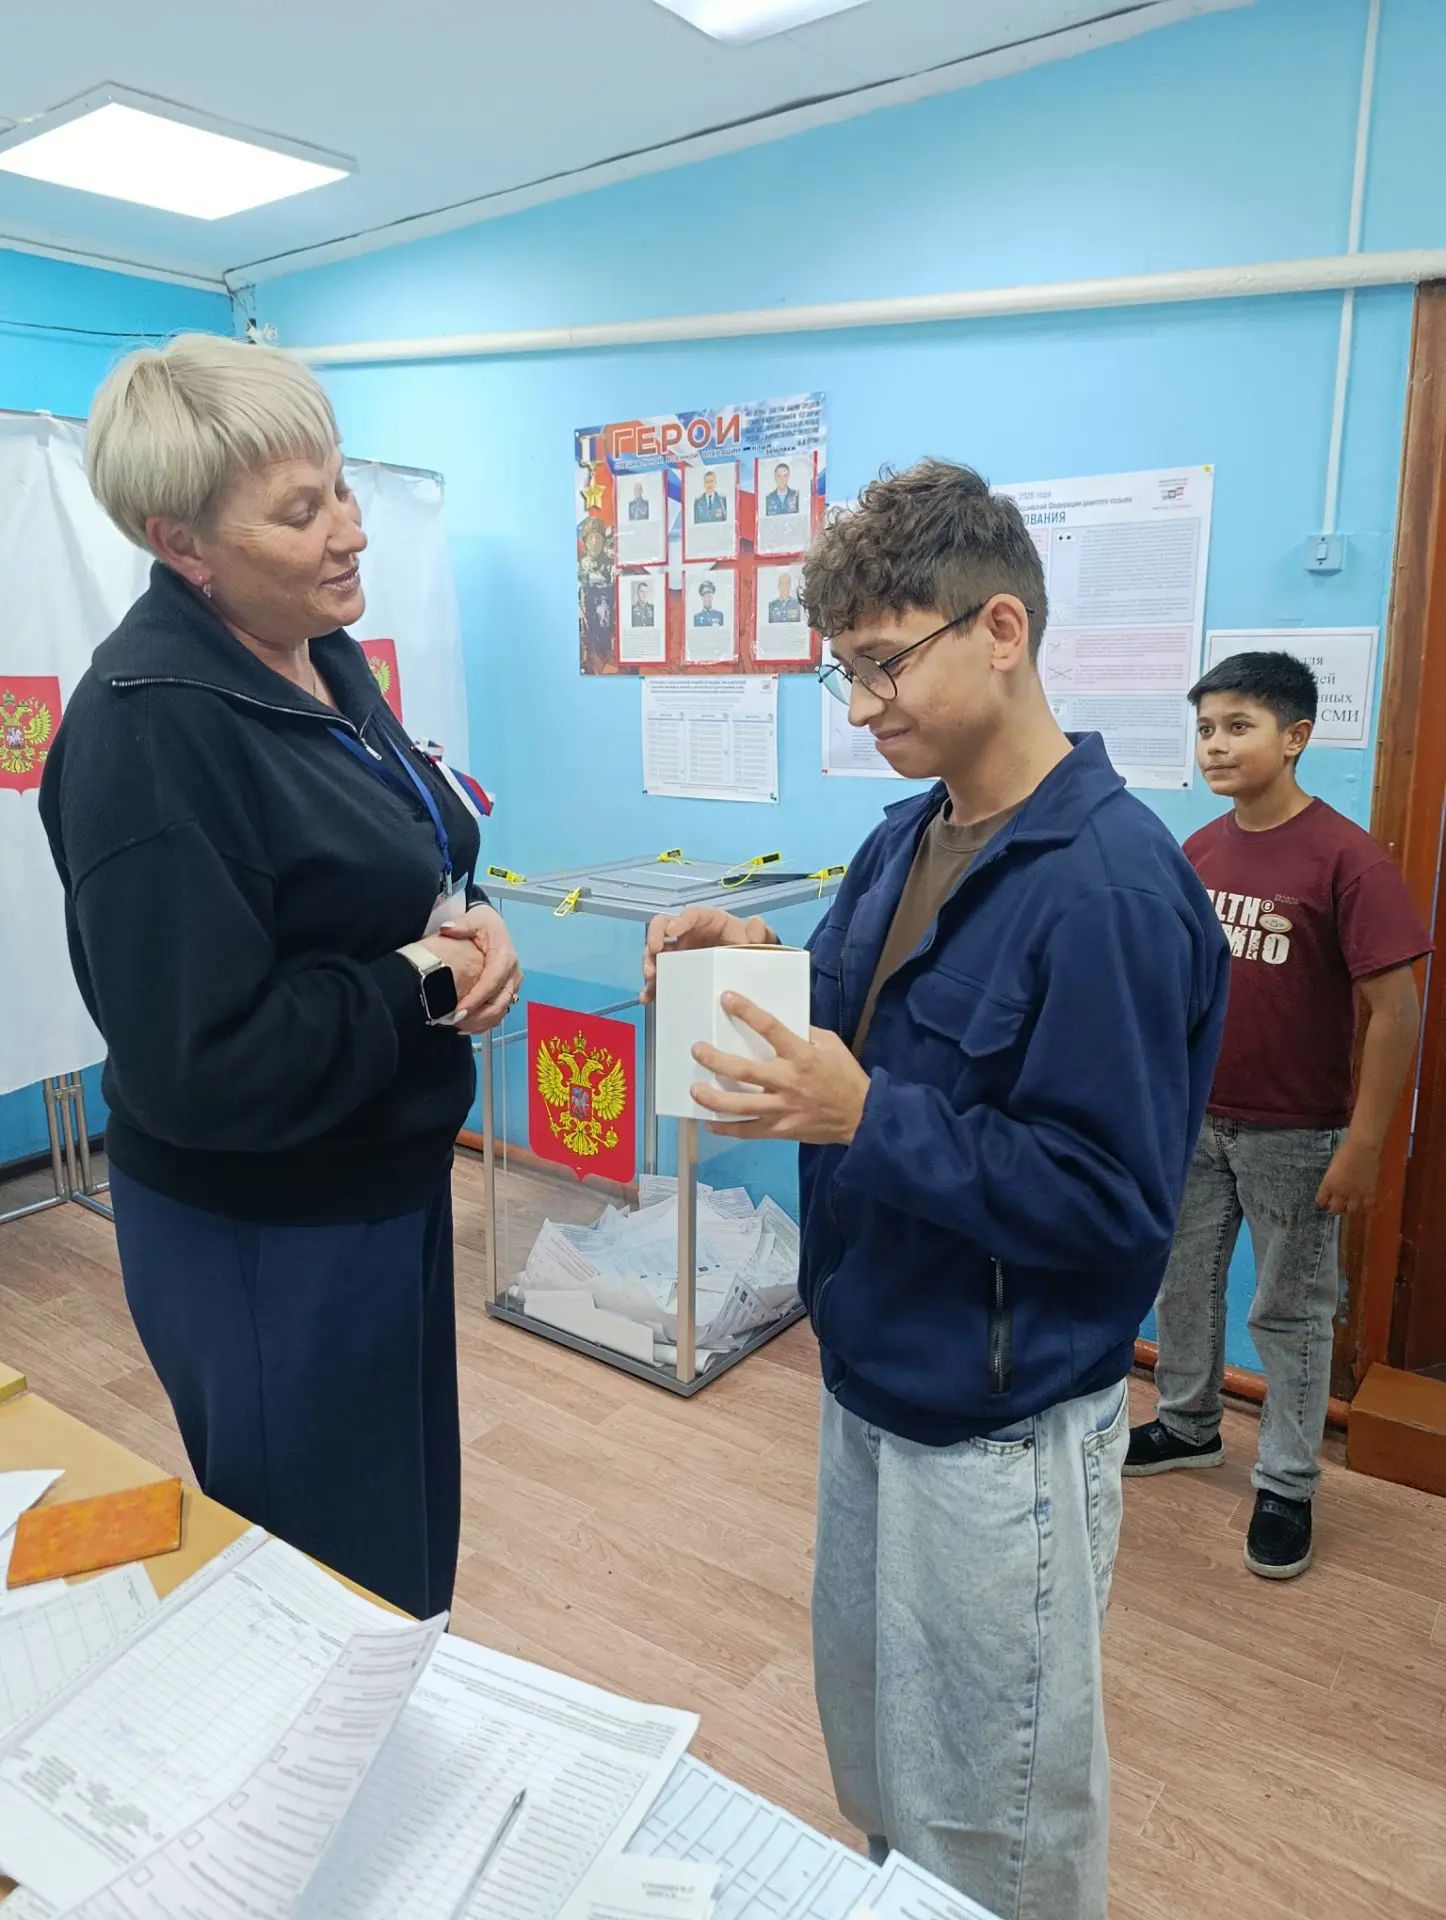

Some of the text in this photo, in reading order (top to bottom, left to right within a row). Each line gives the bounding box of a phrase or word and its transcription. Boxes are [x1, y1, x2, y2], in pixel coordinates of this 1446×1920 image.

[612, 412, 742, 459] ГЕРОИ
[1023, 511, 1066, 526] ОВАНИЯ
[1321, 708, 1360, 723] СМИ
